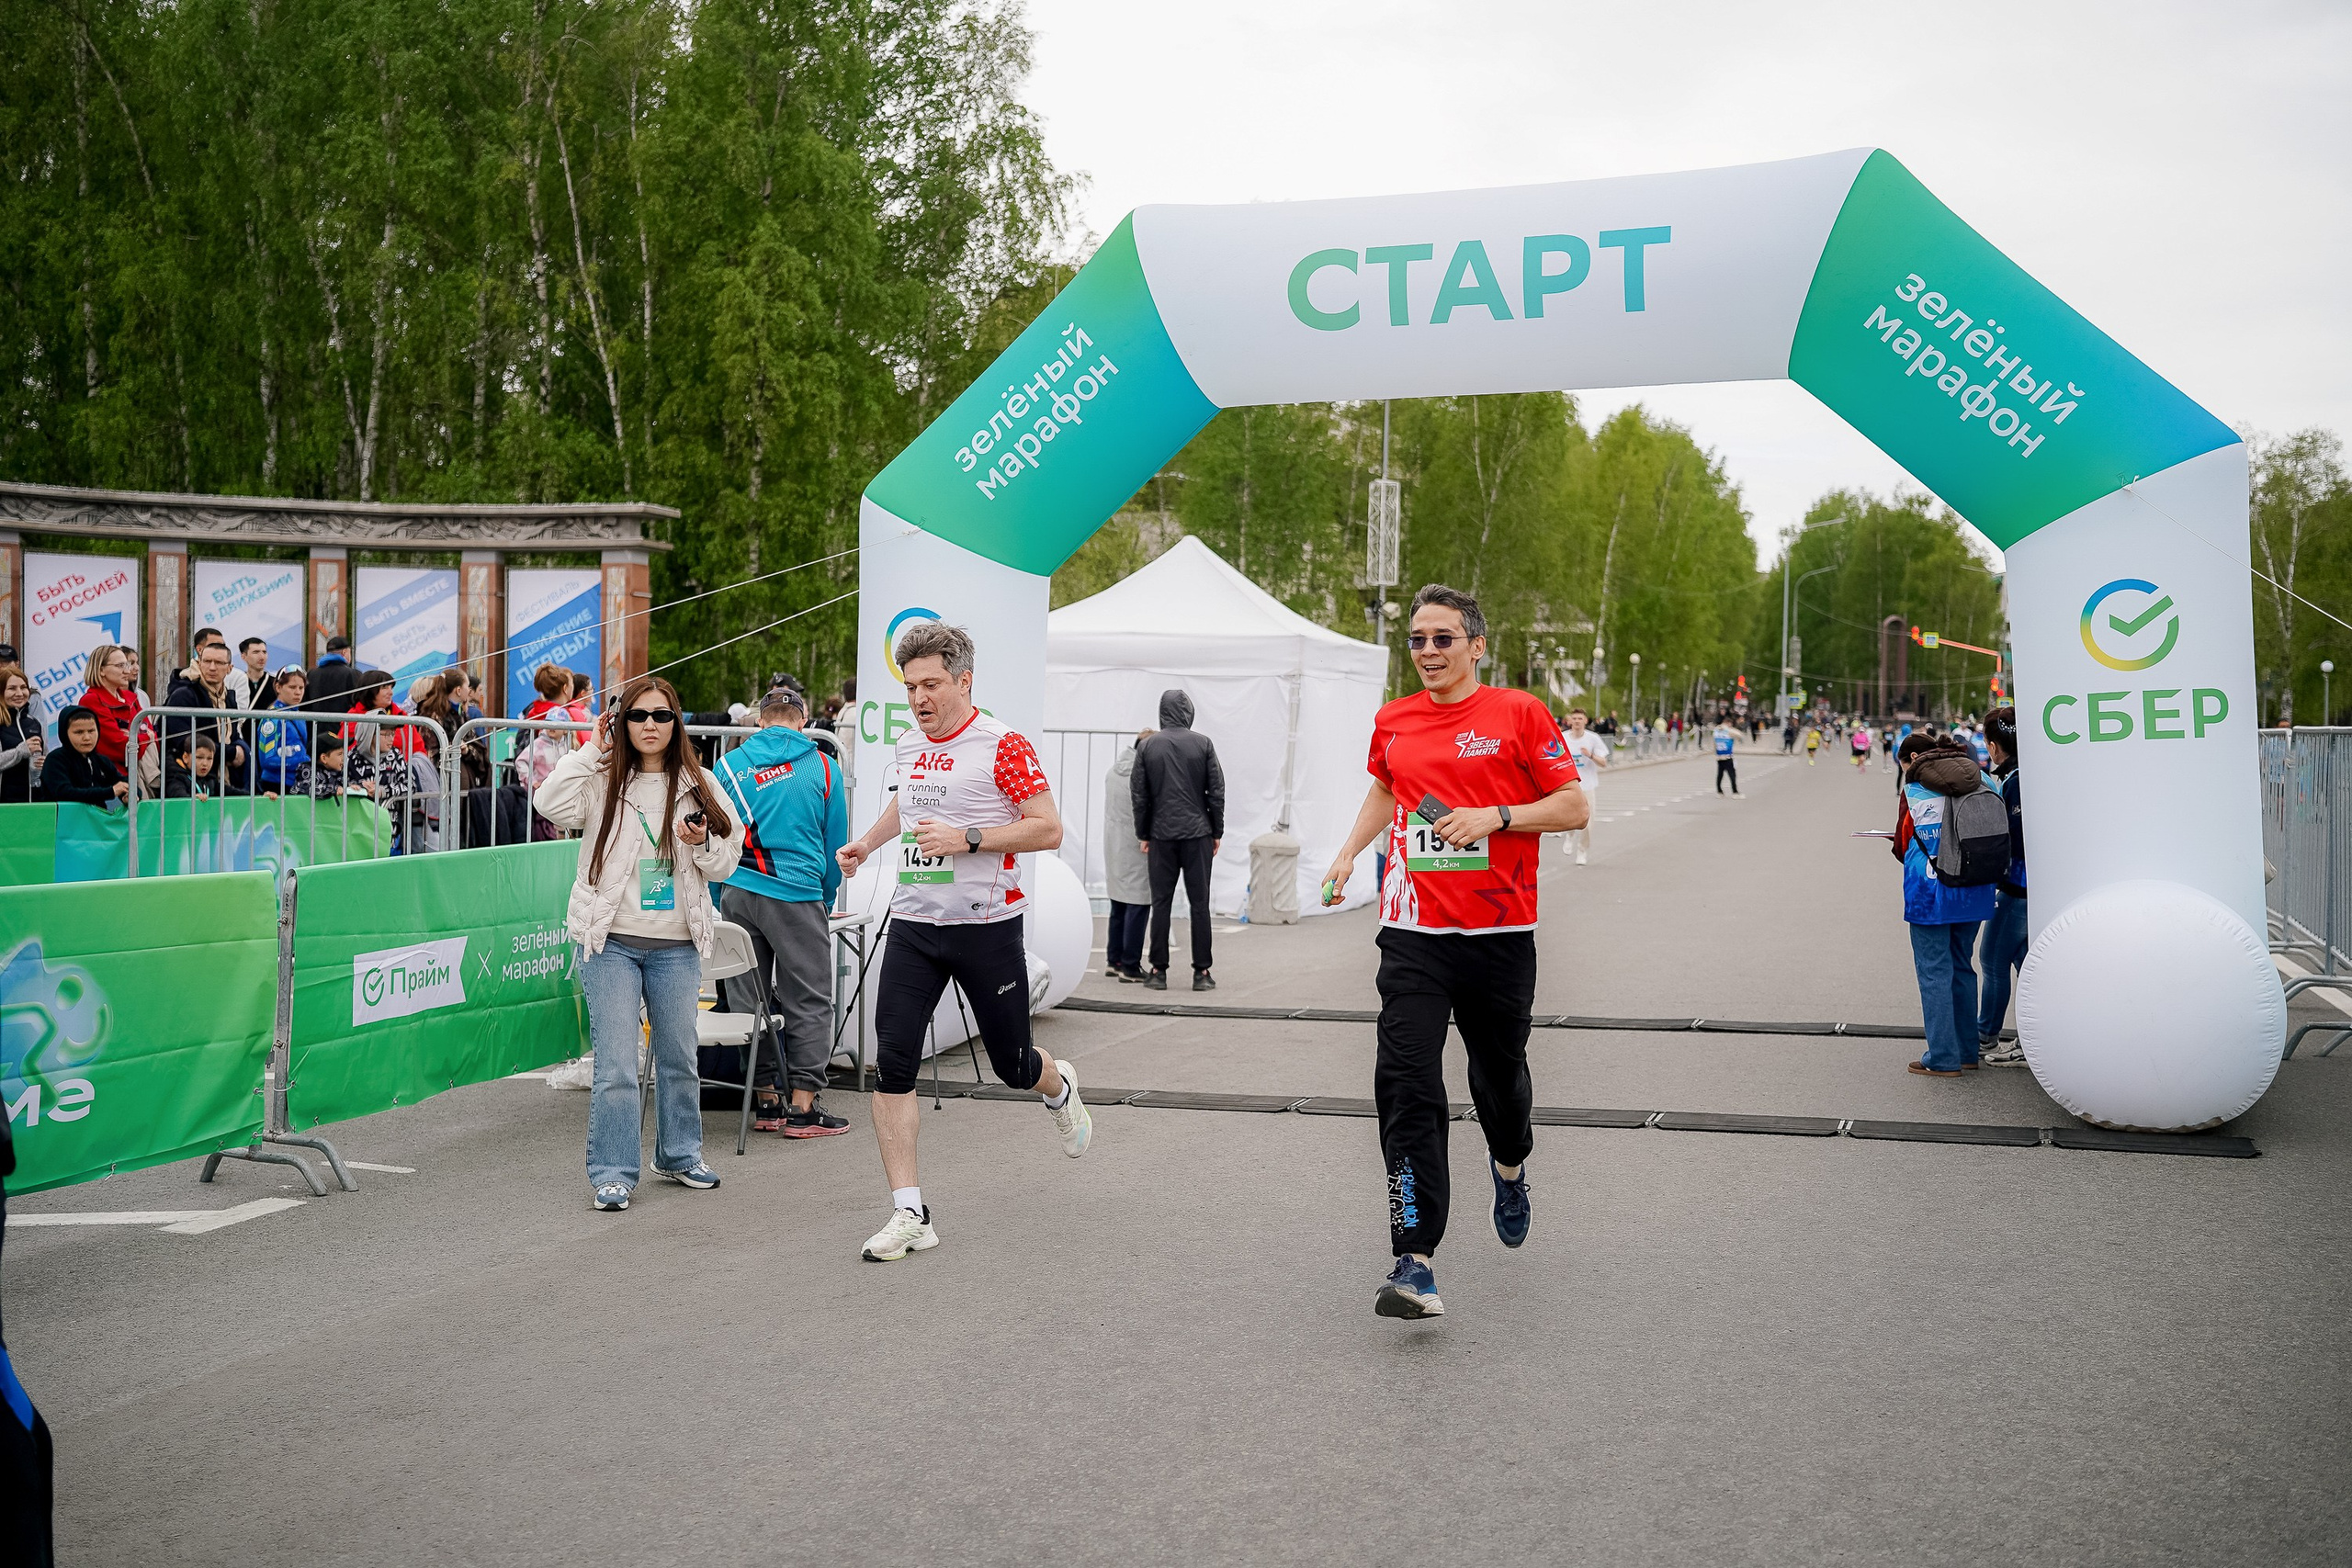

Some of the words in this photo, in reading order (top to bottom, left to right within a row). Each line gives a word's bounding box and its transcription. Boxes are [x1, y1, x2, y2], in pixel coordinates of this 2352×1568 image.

[1287, 226, 1671, 331] СТАРТ
[1894, 273, 2086, 425] зелёный
[955, 321, 1094, 472] зелёный
[1863, 304, 2046, 458] марафон
[975, 354, 1119, 501] марафон
[31, 611, 45, 626] С
[48, 570, 130, 619] РОССИЕЙ
[37, 572, 85, 604] БЫТЬ
[212, 576, 258, 604] БЫТЬ
[515, 581, 581, 623] ФЕСТИВАЛЬ
[519, 607, 594, 662] ДВИЖЕНИЕ
[2042, 688, 2229, 744] СБЕР
[913, 752, 955, 772] Alfa
[1463, 747, 1499, 758] ПАМЯТИ
[1467, 739, 1501, 750] ЗВЕЗДА
[759, 764, 787, 781] TIME
[907, 782, 946, 796] running
[911, 795, 940, 807] team
[1416, 829, 1479, 852] 15
[511, 919, 571, 954] зелёный
[390, 959, 450, 998] Прайм
[503, 951, 564, 983] марафон
